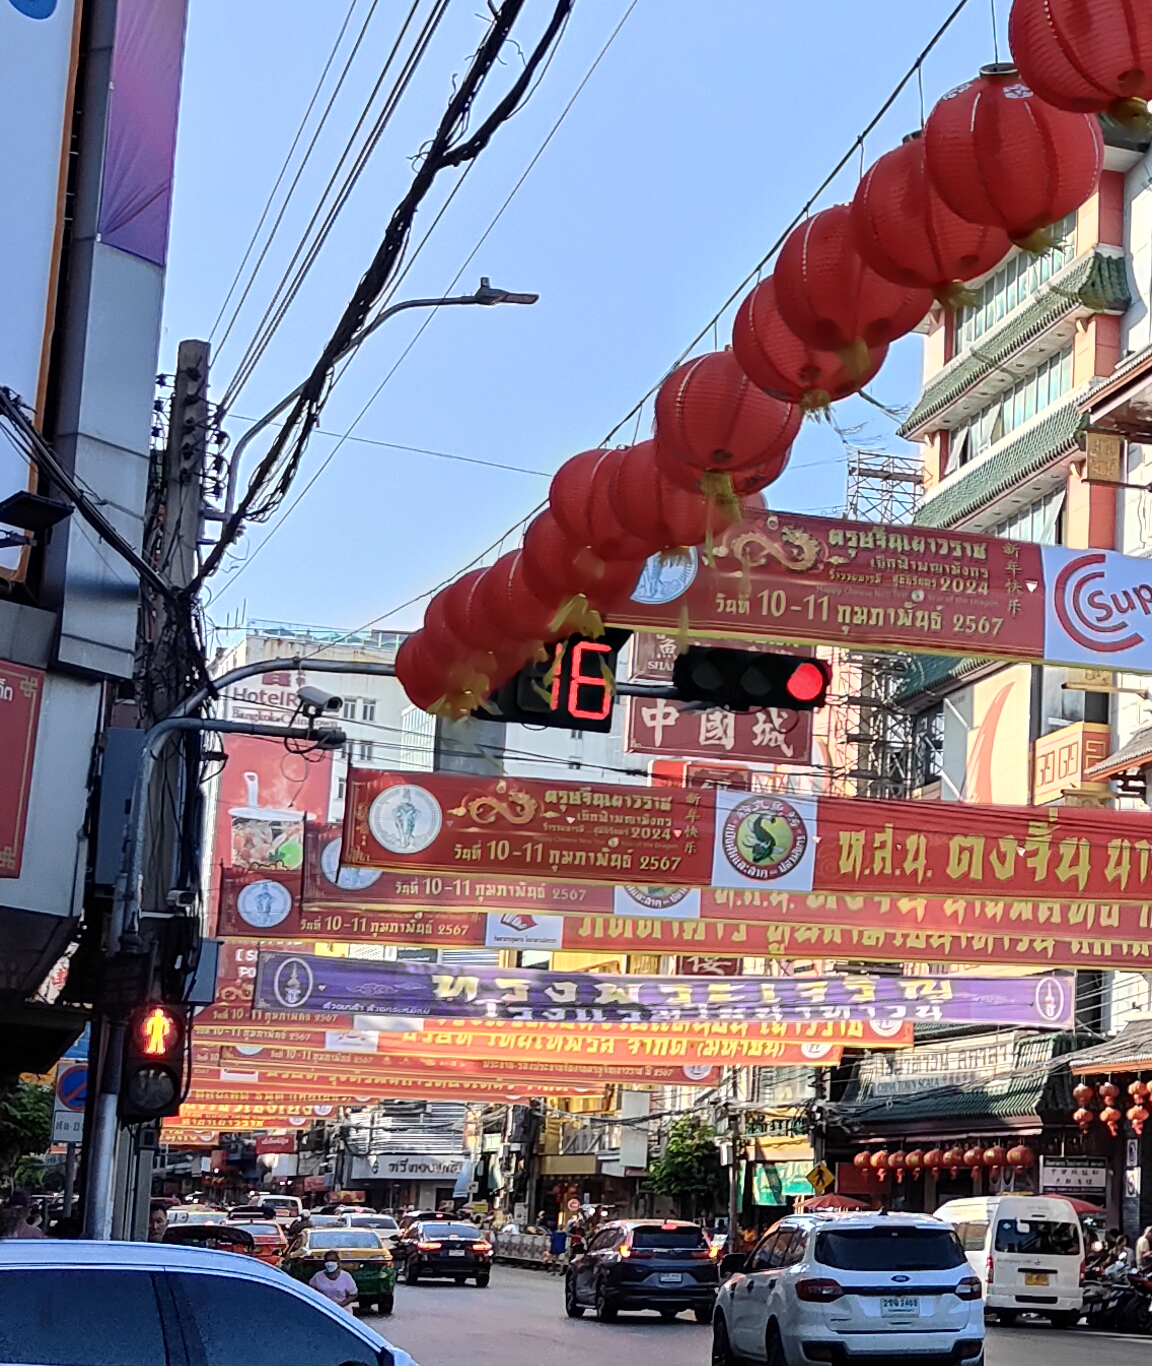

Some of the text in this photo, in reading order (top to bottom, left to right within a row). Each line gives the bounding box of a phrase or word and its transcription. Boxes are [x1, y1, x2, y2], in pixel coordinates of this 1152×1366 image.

[939, 578, 990, 596] 2024
[953, 613, 1005, 637] 2567
[630, 827, 672, 841] 2024
[638, 855, 682, 872] 2567
[552, 888, 587, 901] 2567
[437, 923, 469, 936] 2567
